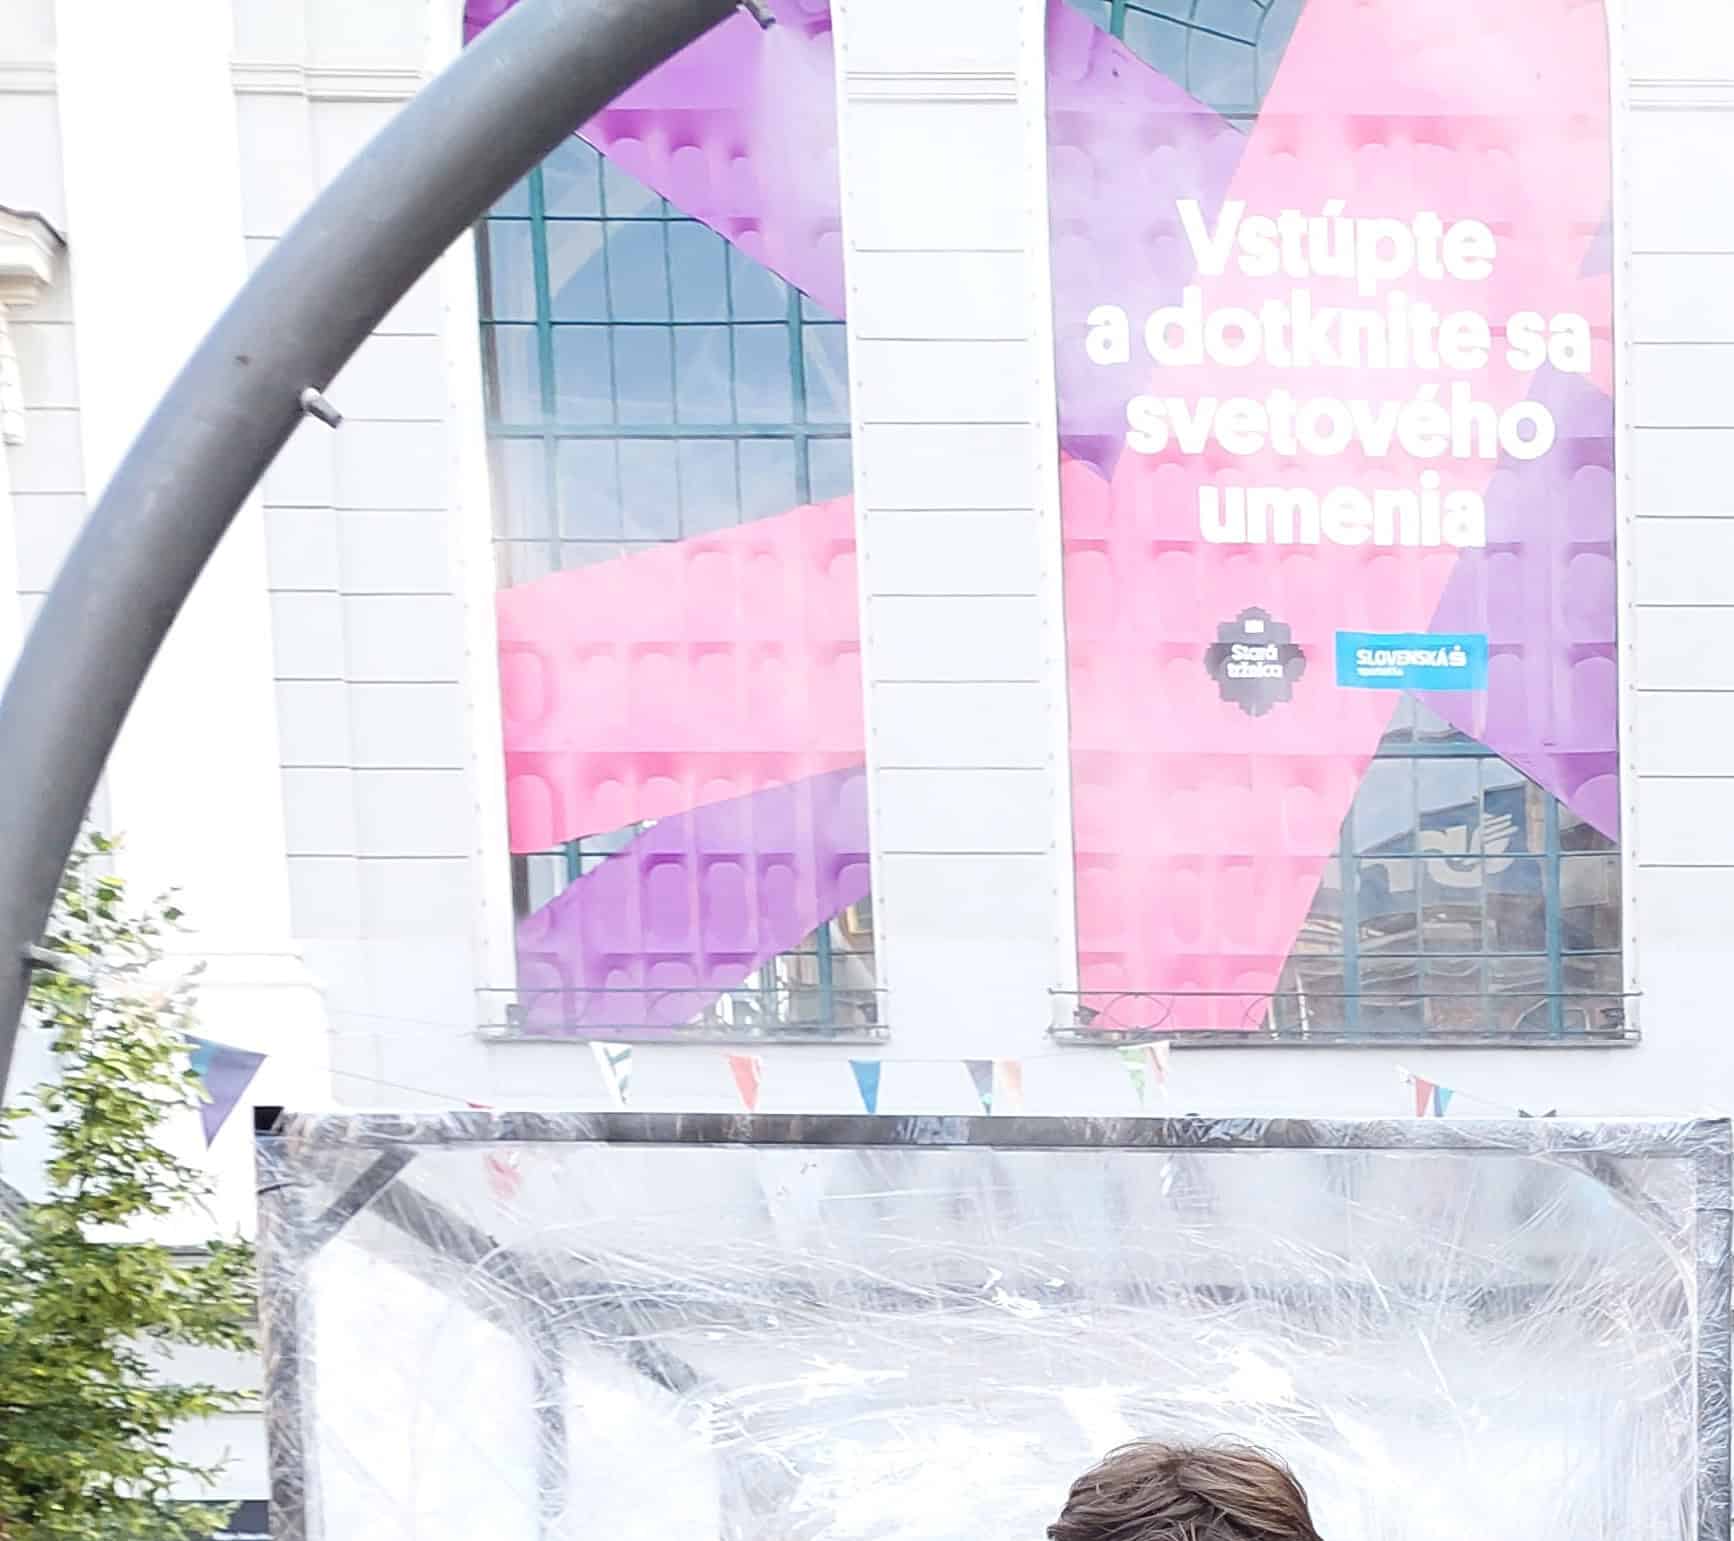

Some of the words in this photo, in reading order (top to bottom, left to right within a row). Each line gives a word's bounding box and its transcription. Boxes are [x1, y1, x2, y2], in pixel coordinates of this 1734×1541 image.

[1176, 200, 1497, 297] Vstúpte
[1086, 304, 1130, 365] a
[1506, 311, 1592, 374] sa
[1126, 381, 1556, 460] svetového
[1200, 470, 1487, 547] umenia
